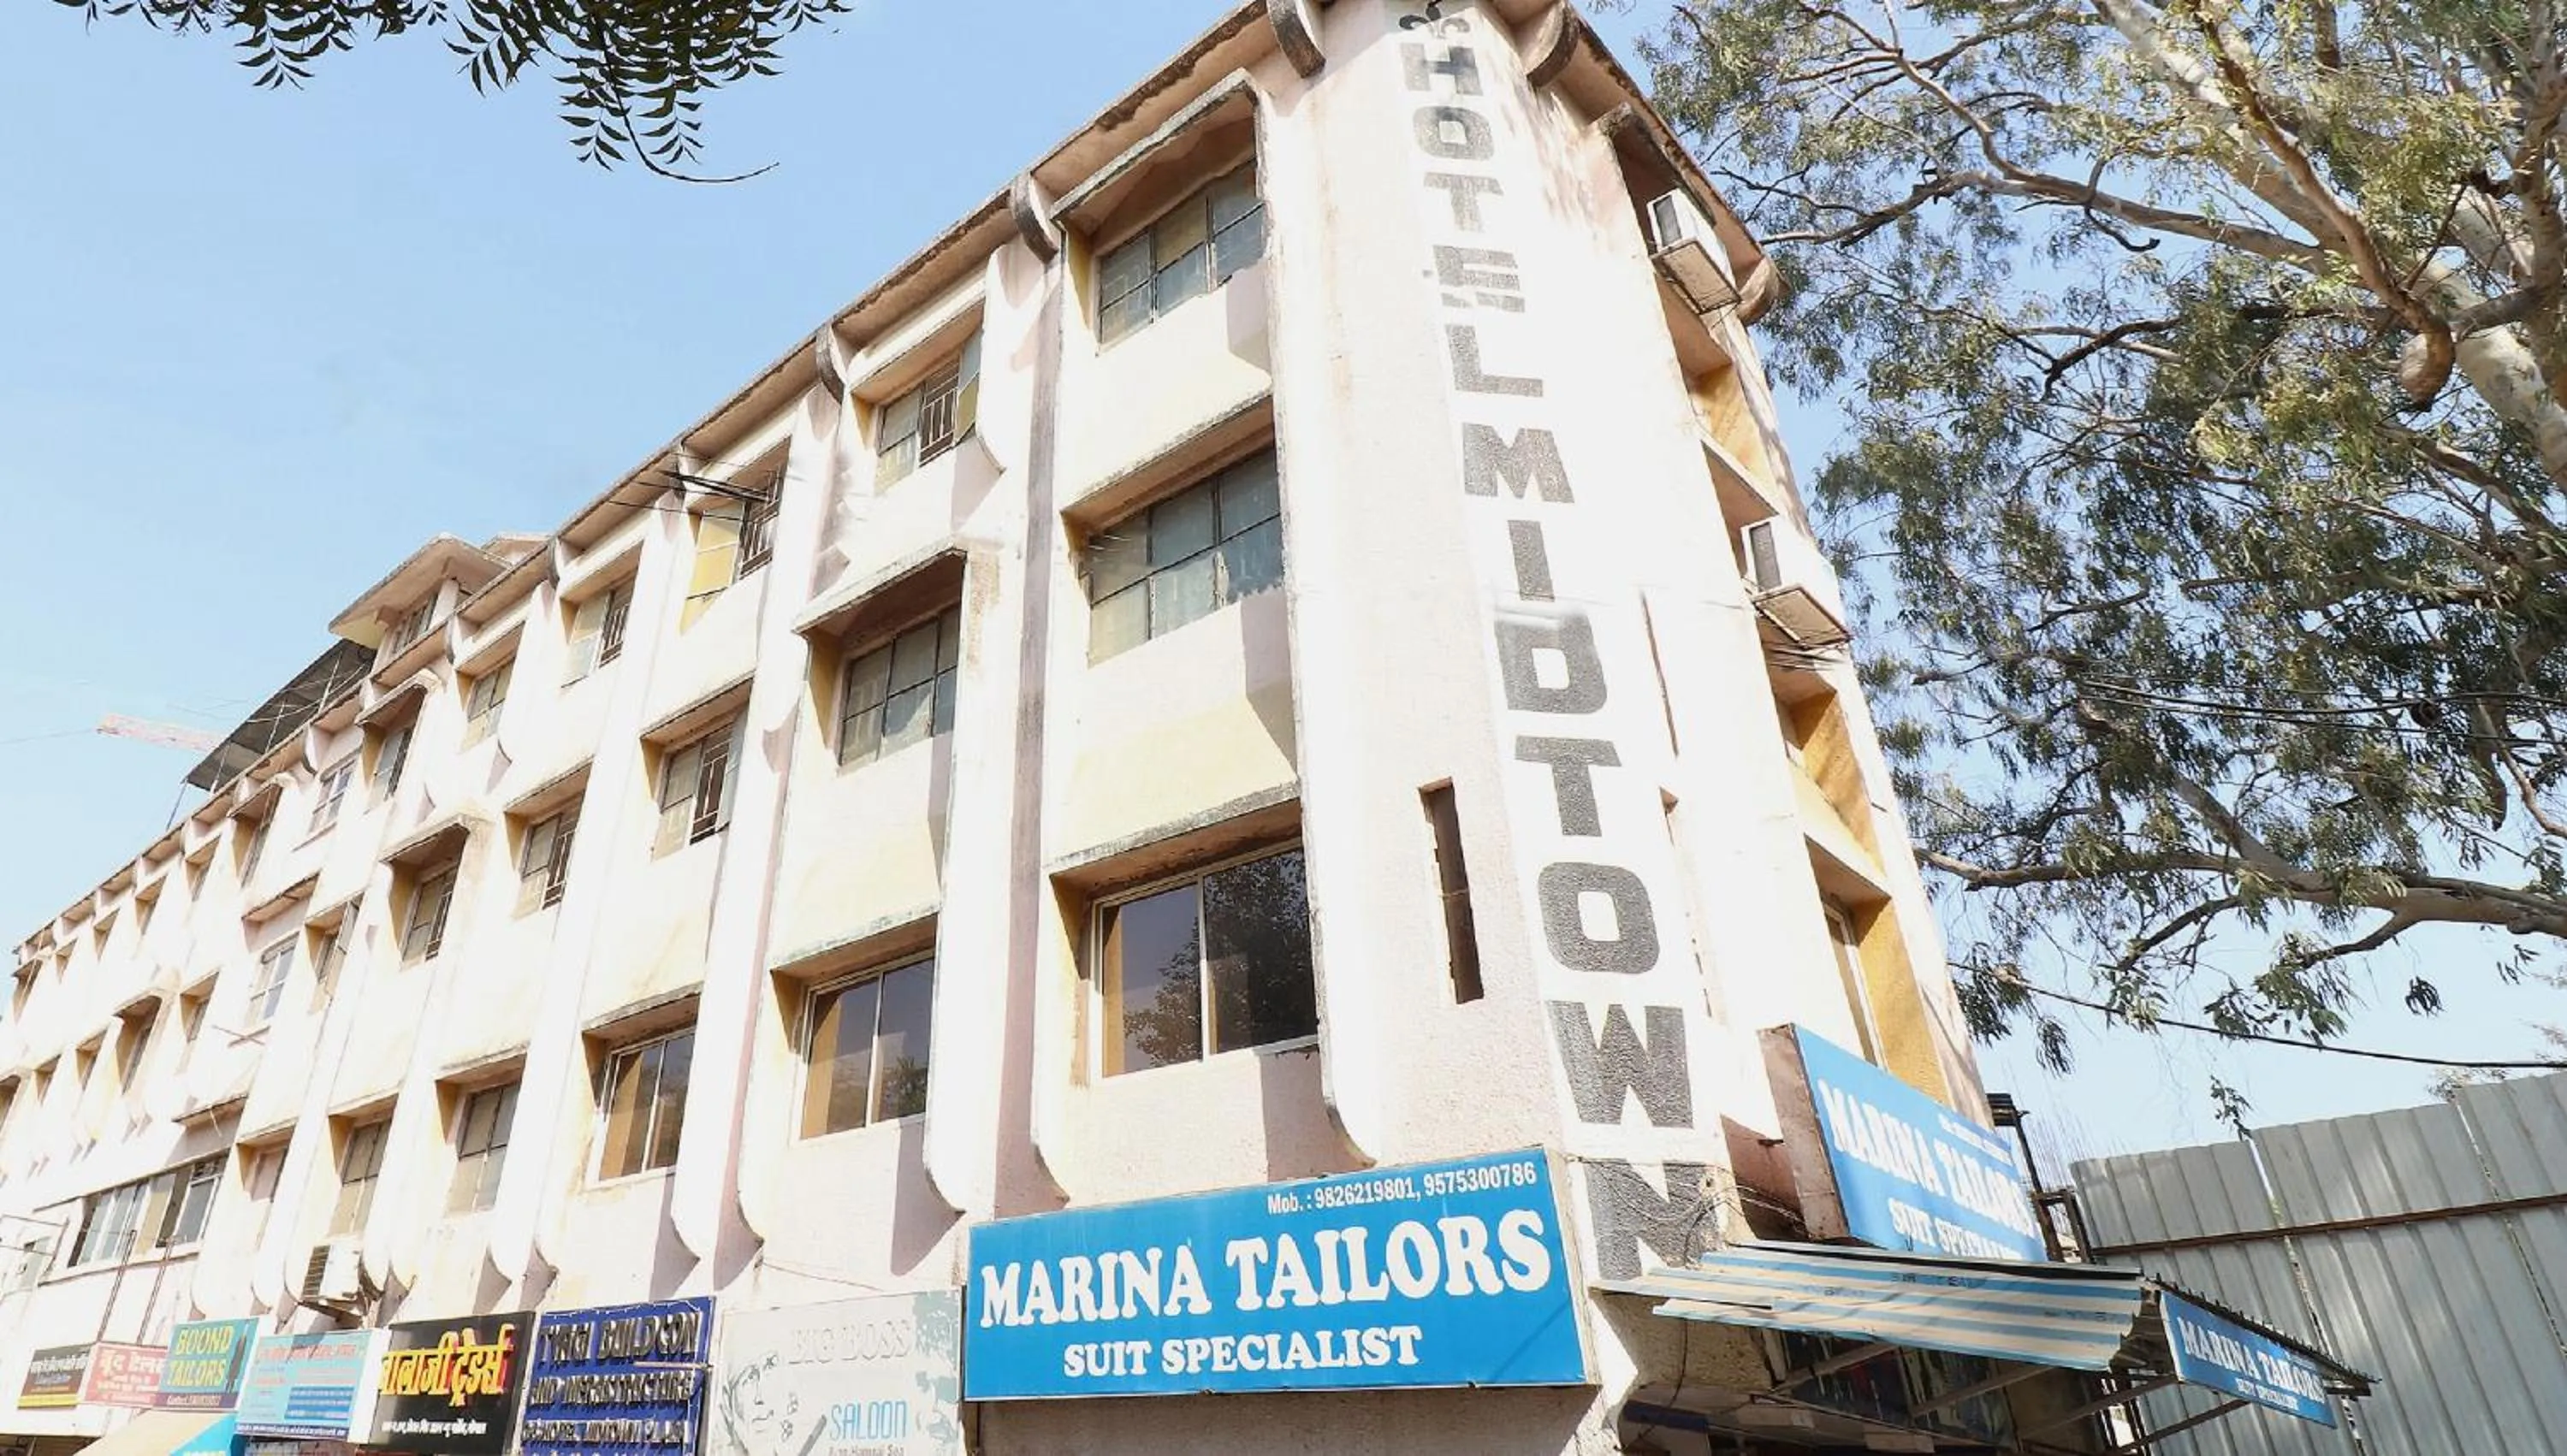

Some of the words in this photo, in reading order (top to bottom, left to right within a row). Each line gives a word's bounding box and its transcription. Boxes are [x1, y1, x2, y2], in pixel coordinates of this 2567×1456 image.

[1399, 42, 1544, 398] HOTEL
[1462, 423, 1725, 1281] MIDTOWN
[1817, 1079, 1947, 1198] MARINA
[1934, 1137, 2040, 1240] TAILORS
[1267, 1193, 1304, 1215] Mob.
[1314, 1178, 1422, 1207] 9826219801,
[1424, 1162, 1537, 1196] 9575300786
[1935, 1218, 2026, 1262] SPECIAL
[980, 1246, 1211, 1328] MARINA
[1226, 1210, 1551, 1310] TAILORS
[176, 1325, 234, 1355] BOOND
[1064, 1341, 1151, 1377] SUIT
[1161, 1325, 1422, 1372] SPECIALIST
[2177, 1317, 2262, 1381] MARINA
[2256, 1350, 2326, 1405] TAILORS
[168, 1358, 226, 1387] TAILORS
[829, 1400, 908, 1441] SALOON
